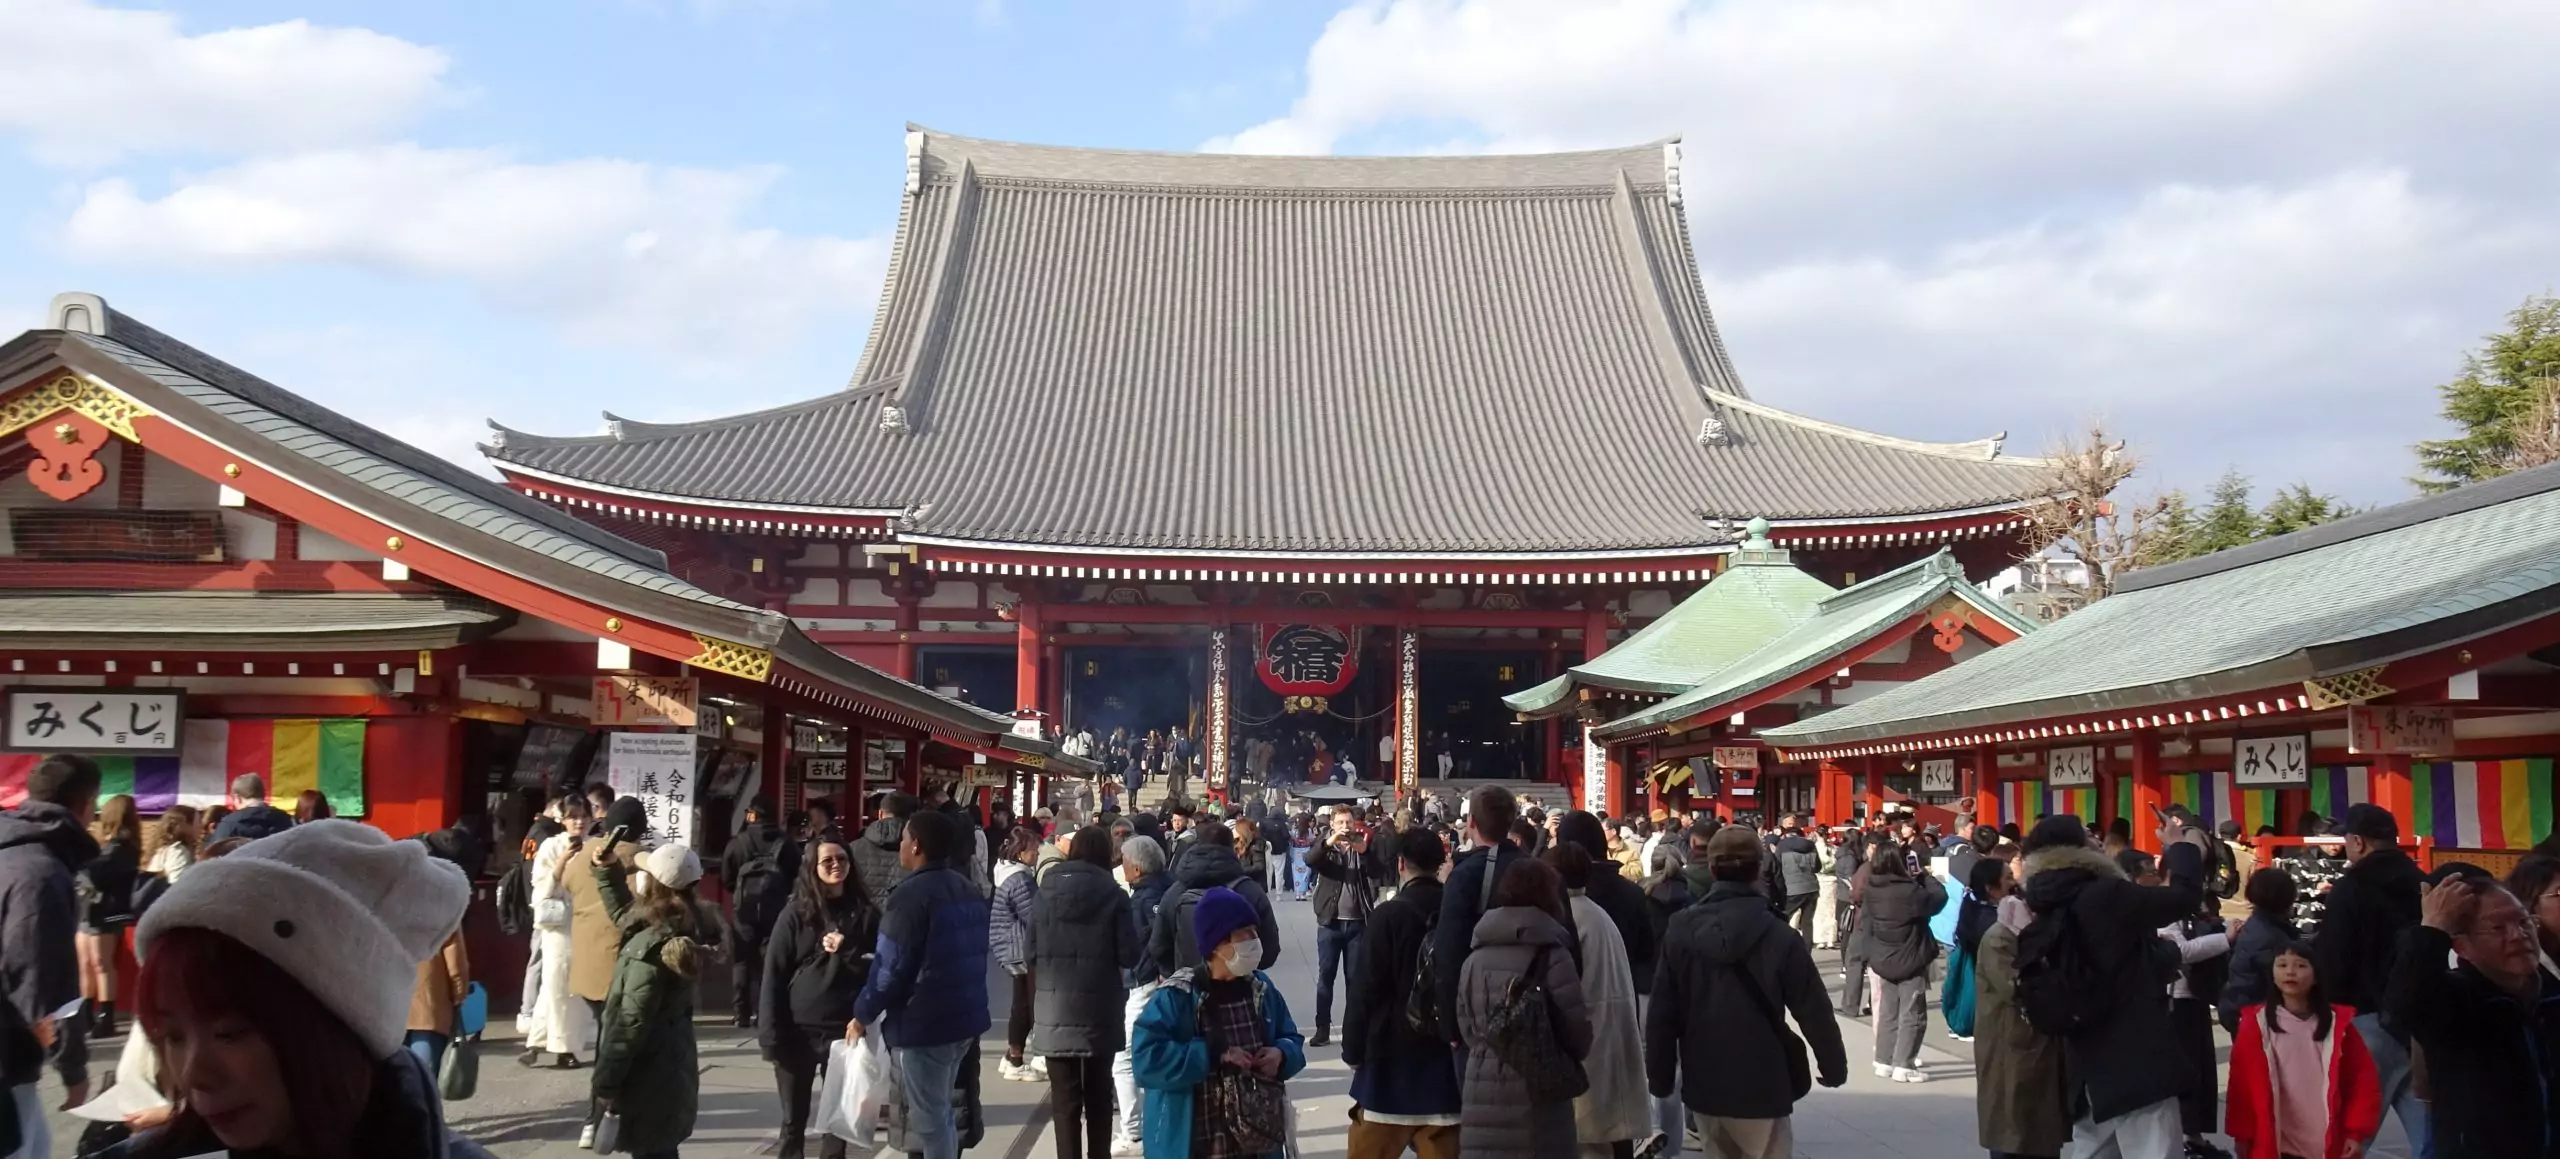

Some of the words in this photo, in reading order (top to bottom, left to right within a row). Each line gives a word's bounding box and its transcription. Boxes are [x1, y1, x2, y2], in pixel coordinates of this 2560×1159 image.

[26, 700, 162, 738] みくじ
[1925, 762, 1953, 786] みくじ
[2054, 752, 2091, 779] みくじ
[2244, 742, 2302, 777] みくじ
[640, 771, 660, 847] 義援金
[664, 767, 686, 844] 令和6年
